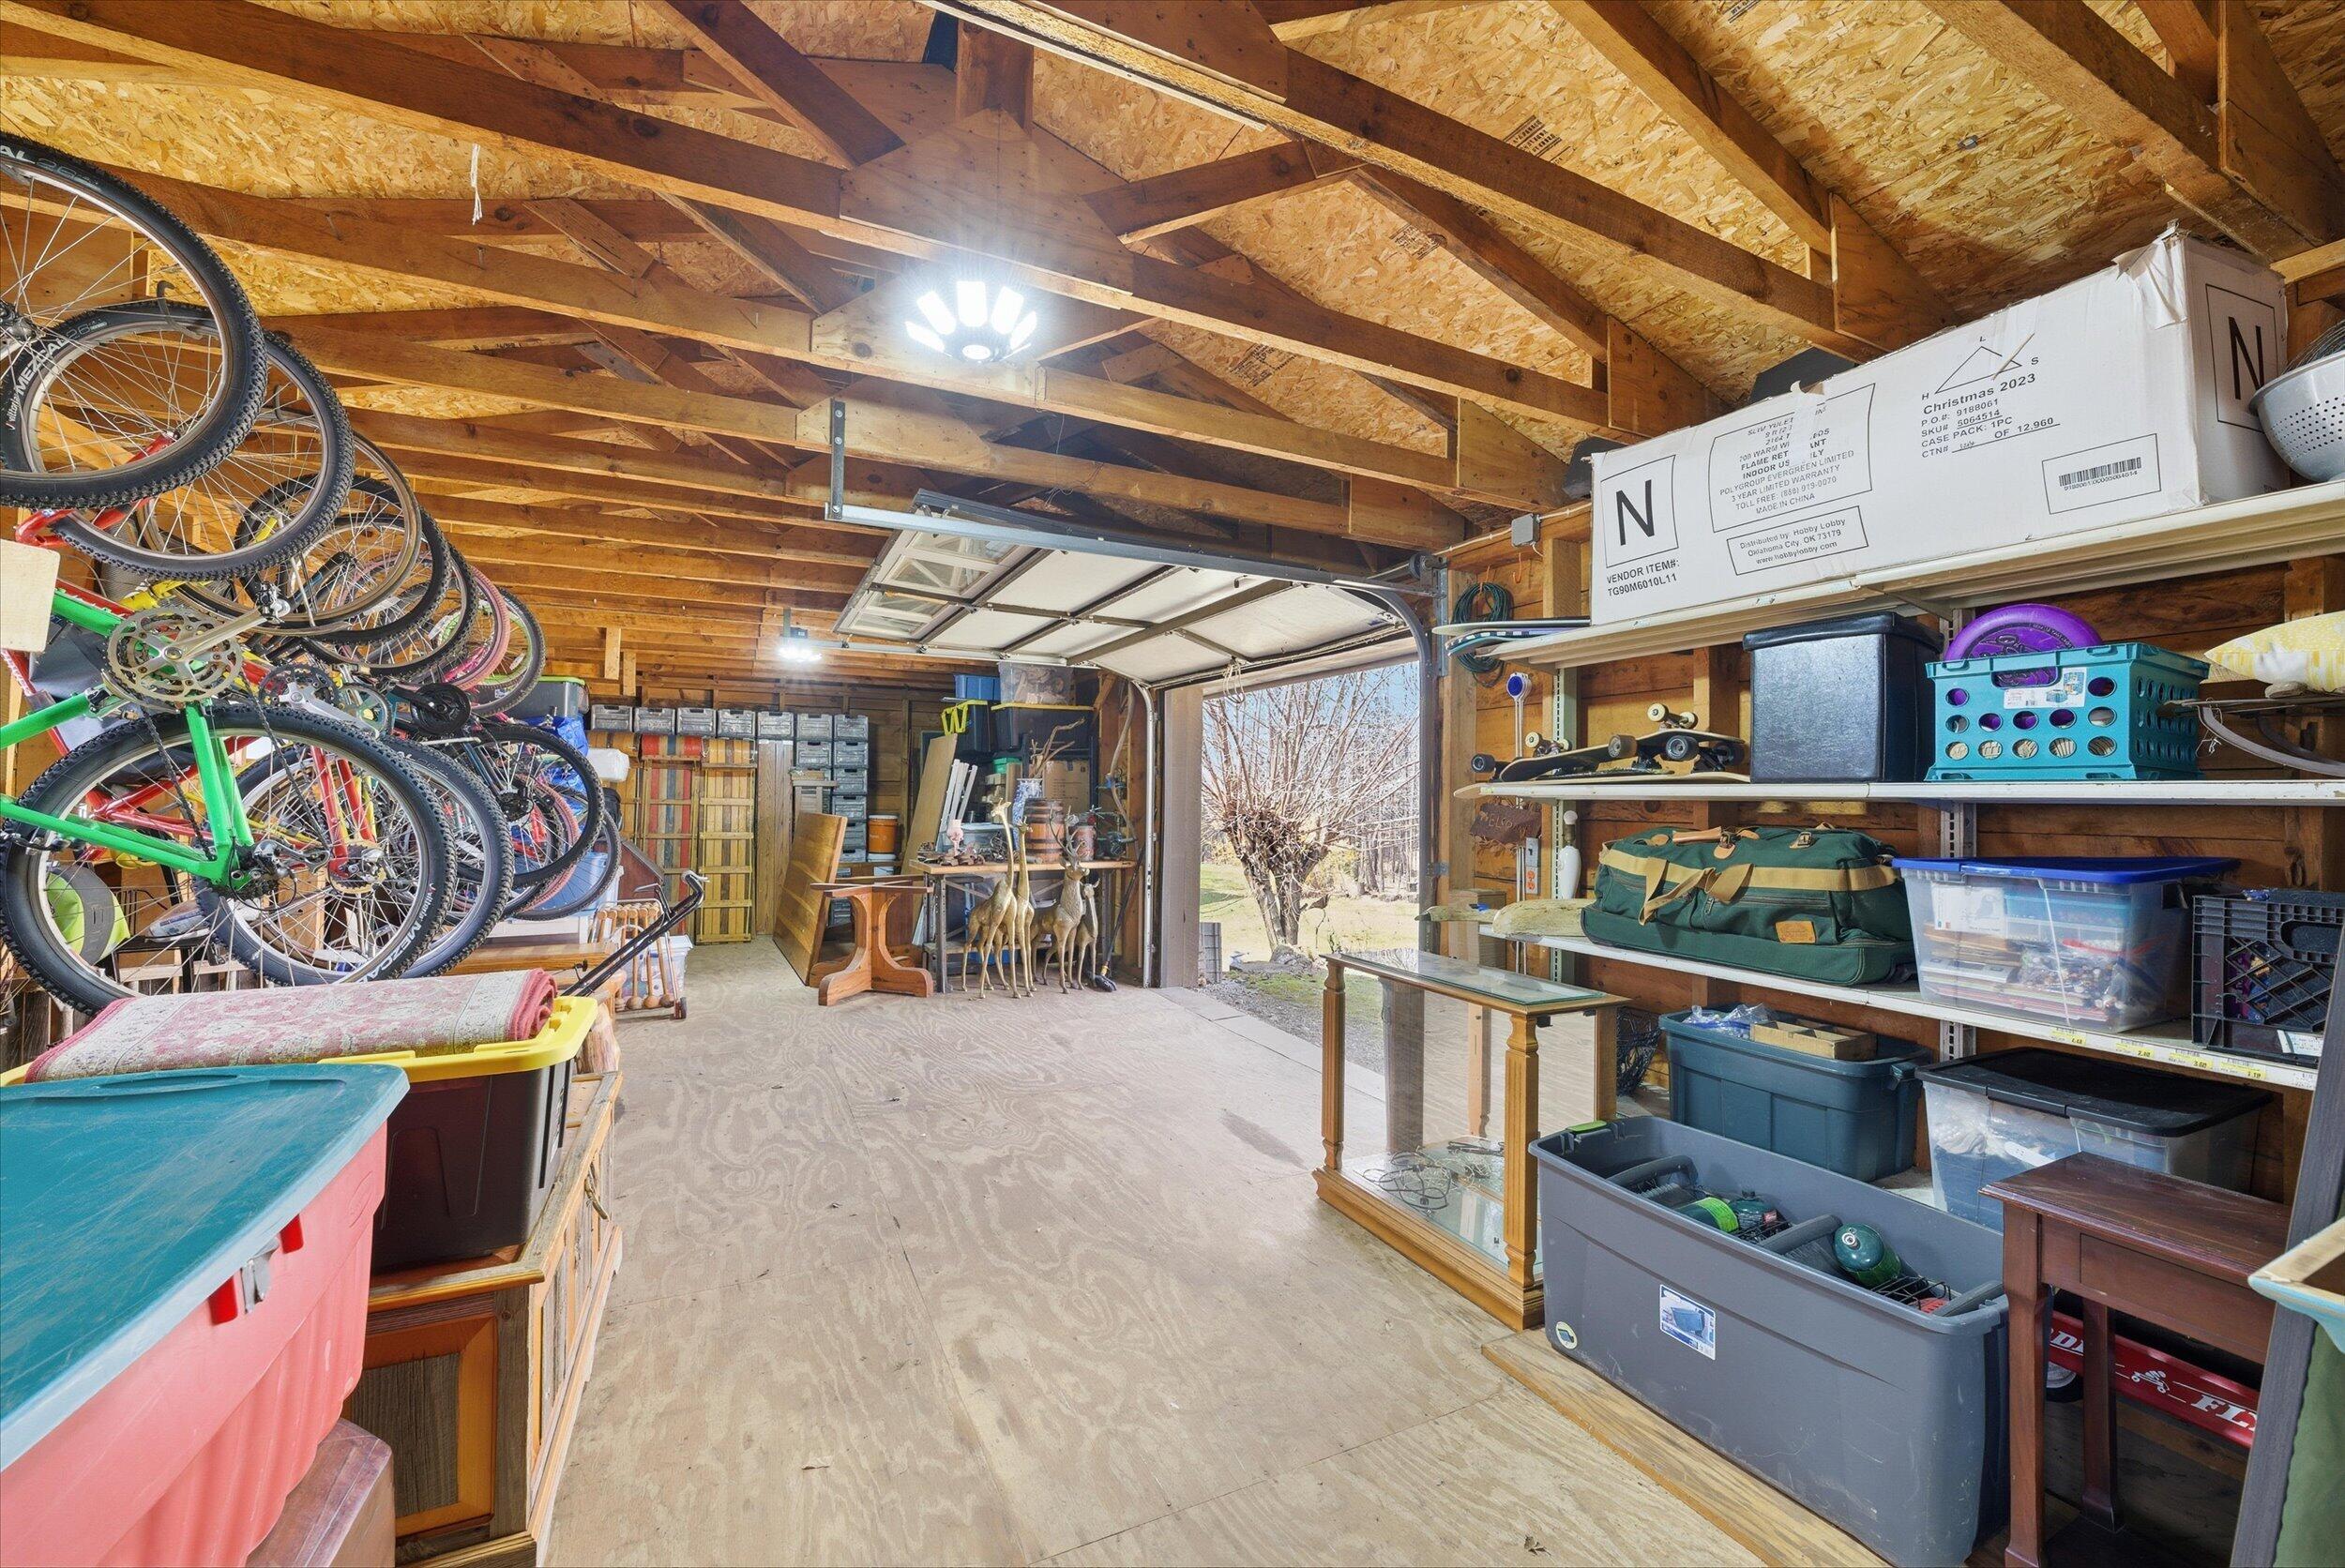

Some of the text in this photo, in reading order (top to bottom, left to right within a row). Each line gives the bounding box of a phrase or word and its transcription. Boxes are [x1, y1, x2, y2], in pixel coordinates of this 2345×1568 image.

[2031, 356, 2039, 366] S
[2229, 316, 2265, 400] N
[1921, 392, 1929, 400] H
[1923, 373, 2035, 415] Christmas 2023
[1956, 399, 1999, 416] 9188061
[1921, 409, 2001, 437] SKU# 5064514
[1921, 434, 1950, 448] CASE
[1953, 424, 1988, 439] PACK:
[1990, 416, 2013, 429] 1PC
[1922, 445, 1949, 459] CTN#
[1994, 429, 2010, 439] OF
[1719, 450, 1854, 495] POLYGROUP EVERGREEN LIMITED
[1741, 458, 1769, 471] FLAME
[1743, 465, 1776, 479] INDOOR
[1737, 489, 1758, 500] YEAR
[1760, 479, 1790, 494] LIMITED
[1792, 464, 1841, 485] WARRANTY
[1616, 479, 1655, 546] N
[1735, 500, 1754, 510] TOLL
[1756, 493, 1815, 515] MADE IN CHINA
[1740, 535, 1778, 550] Distributed
[1793, 524, 1818, 536] Hobby
[1820, 519, 1846, 530] Lobby
[1747, 543, 1783, 557] Oklahoma
[1803, 535, 1816, 544] OK
[1818, 529, 1841, 541] 73179
[1607, 559, 1680, 583] VENDOR ITEM#:
[1608, 573, 1676, 596] TG90M6010L11
[2191, 1395, 2258, 1431] FL
